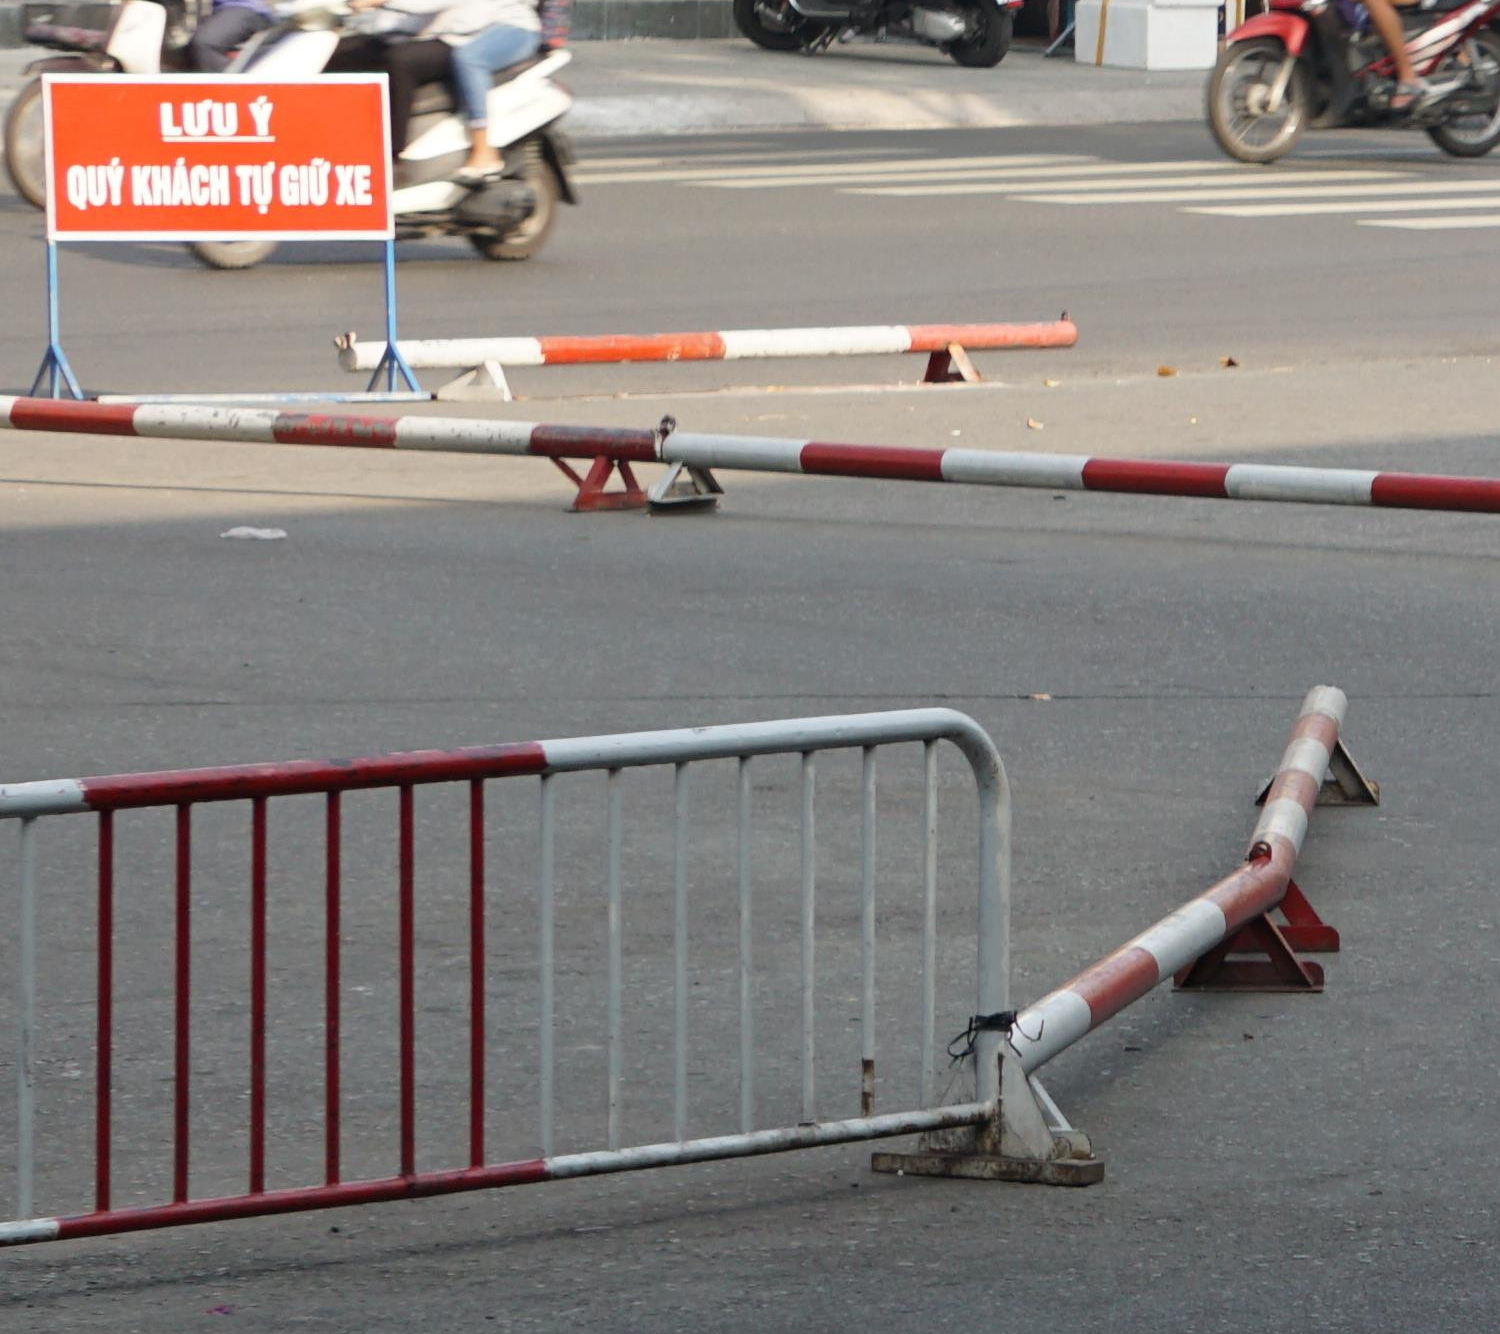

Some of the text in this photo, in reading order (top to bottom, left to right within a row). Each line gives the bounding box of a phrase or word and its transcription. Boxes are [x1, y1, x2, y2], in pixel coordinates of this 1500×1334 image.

[159, 95, 274, 137] LƯU Ý
[67, 157, 373, 215] QUÝ KHÁCH TỰ GIỮ XE
